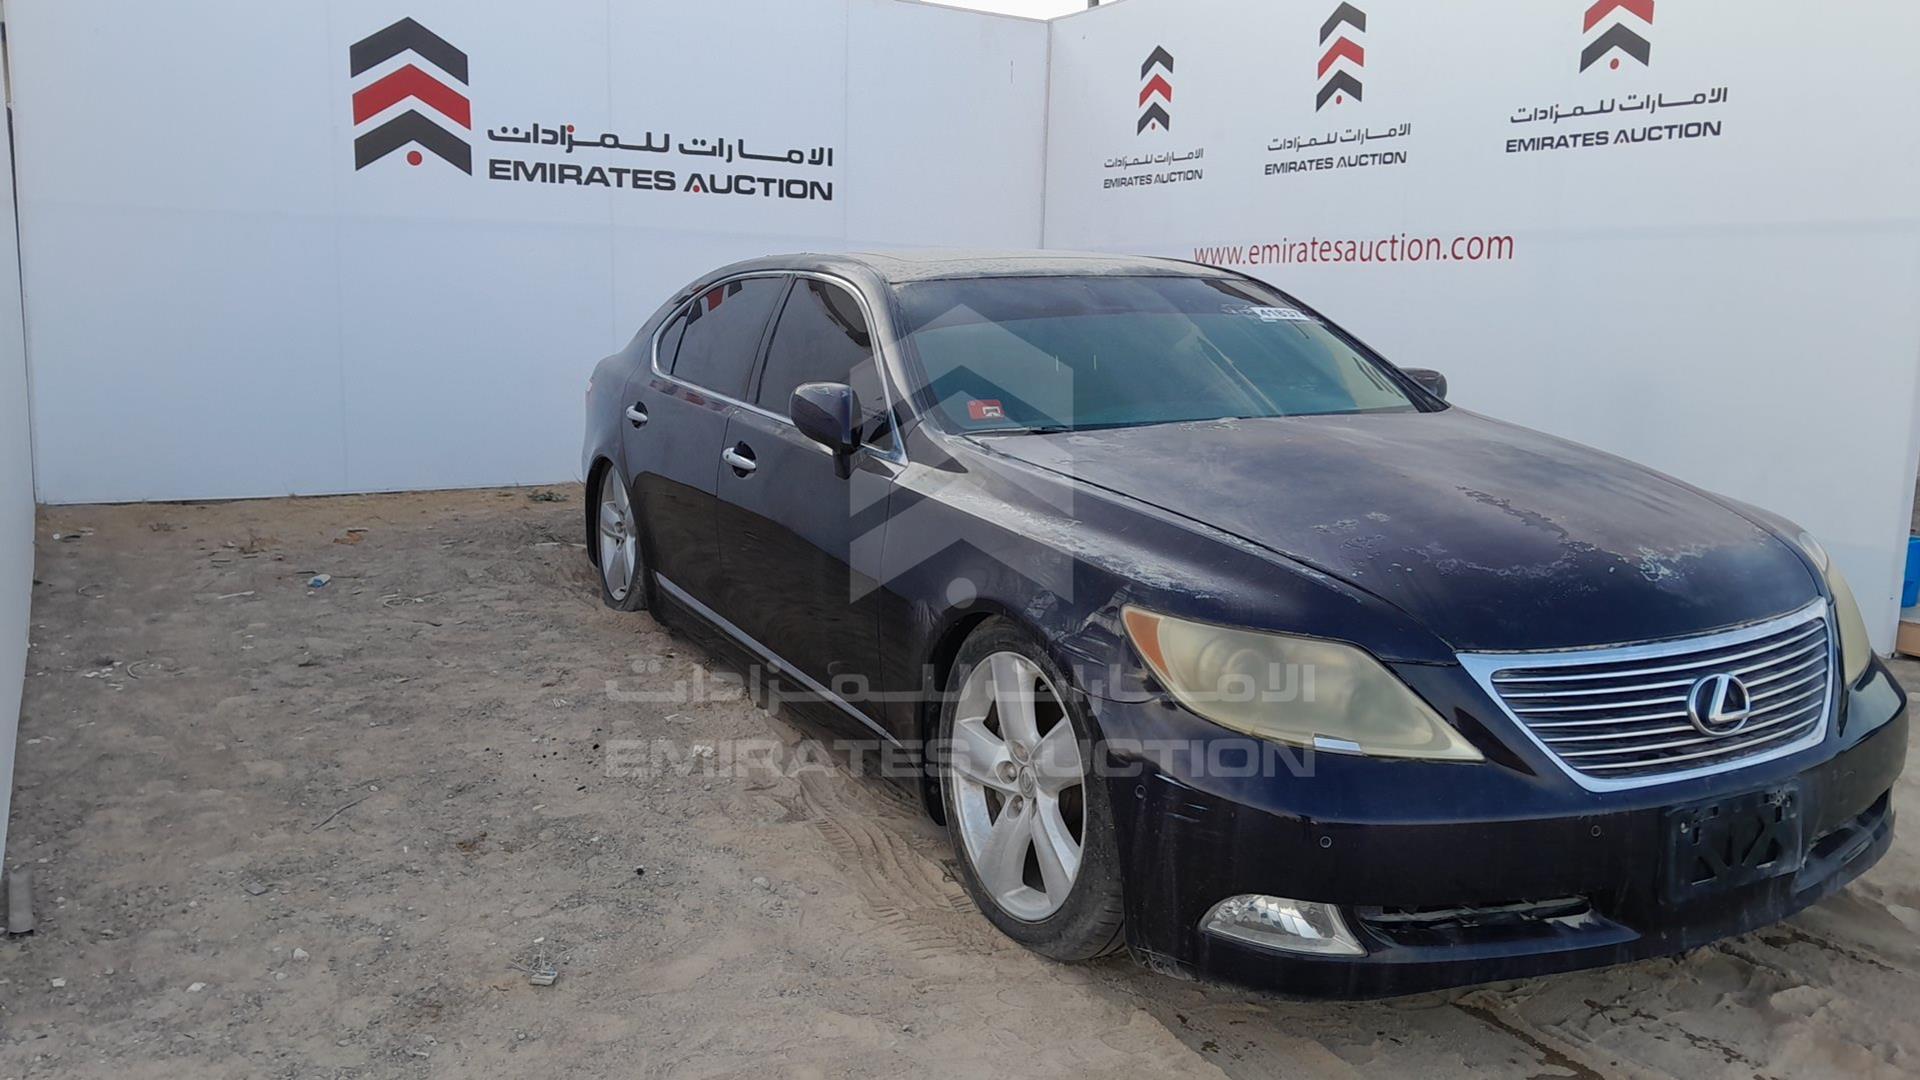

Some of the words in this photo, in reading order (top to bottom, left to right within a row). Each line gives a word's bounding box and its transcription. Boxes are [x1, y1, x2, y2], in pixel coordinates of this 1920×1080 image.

[1510, 98, 1616, 124] للمزادات
[487, 123, 671, 154] للمزادات
[1506, 131, 1609, 153] EMIRATES
[1613, 121, 1722, 145] AUCTION
[1103, 174, 1153, 190] EMIRATES
[1154, 168, 1204, 185] AUCTION
[1264, 157, 1334, 176] EMIRATES
[1336, 151, 1407, 169] AUCTION
[489, 159, 677, 192] EMIRATES
[683, 173, 833, 201] AUCTION
[1194, 233, 1514, 266] www.emiratesauction.com
